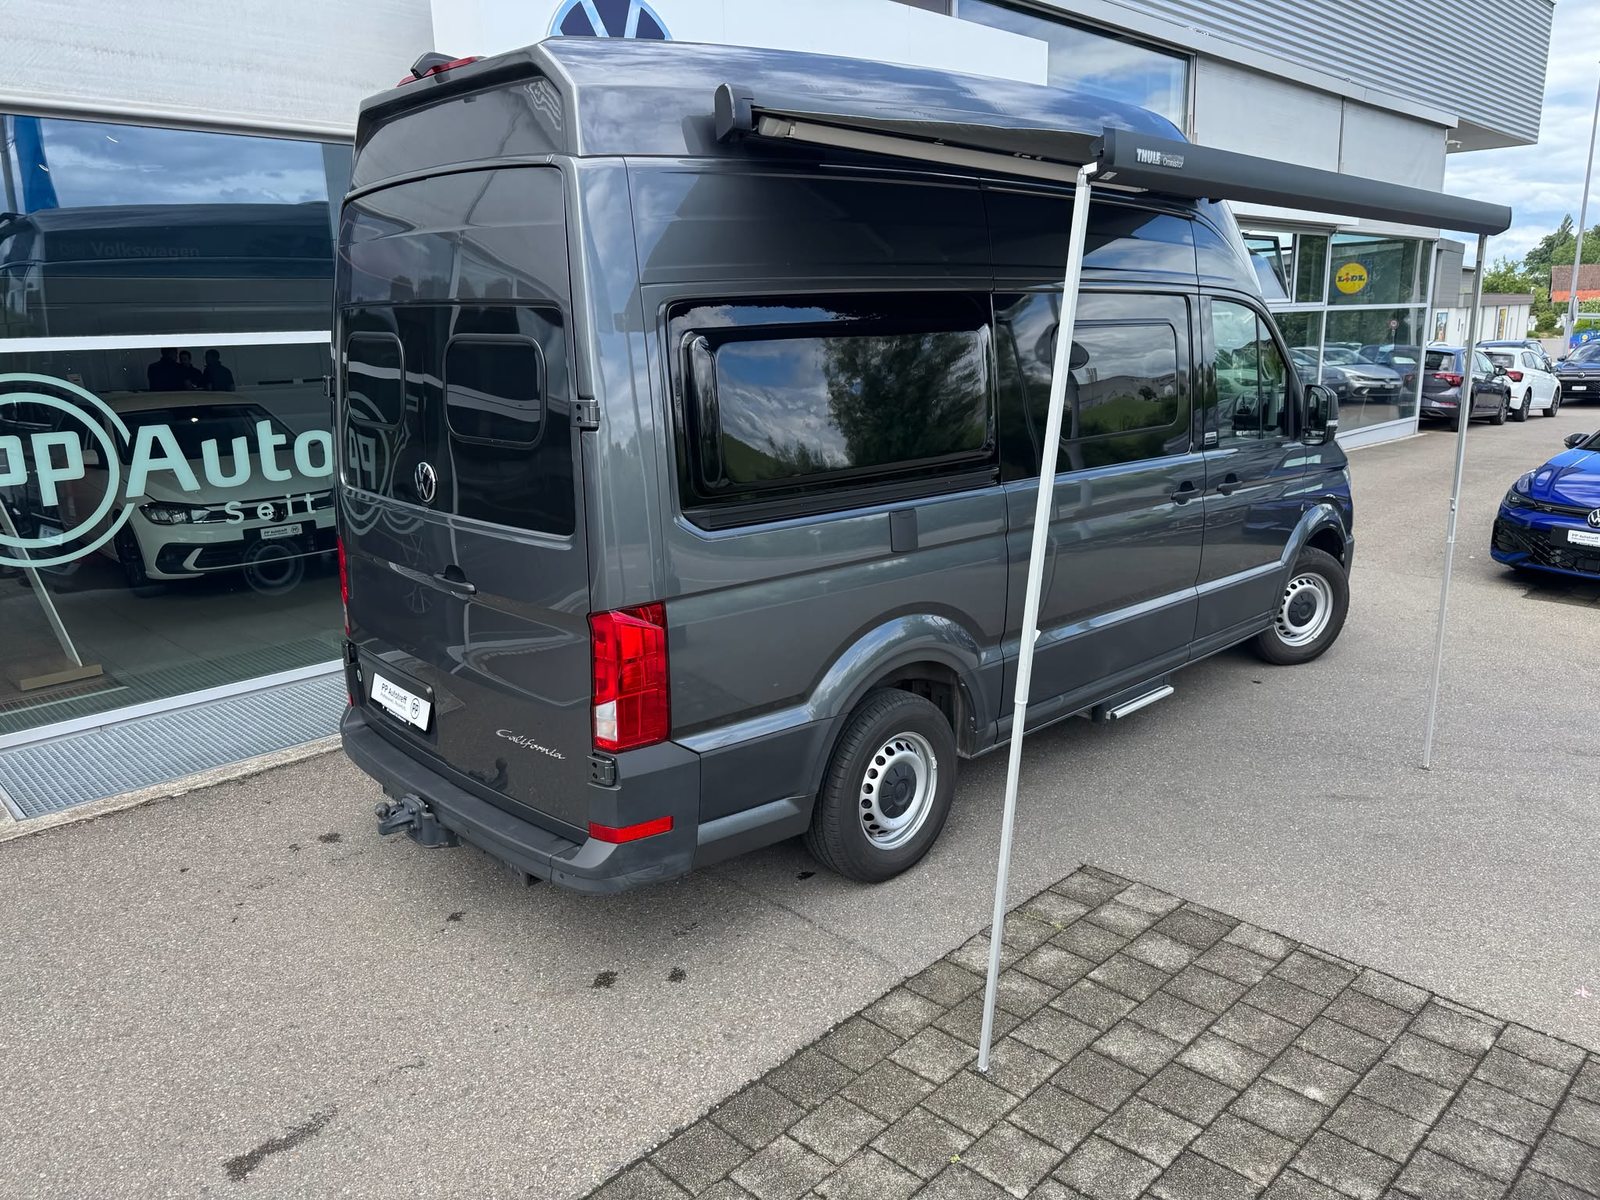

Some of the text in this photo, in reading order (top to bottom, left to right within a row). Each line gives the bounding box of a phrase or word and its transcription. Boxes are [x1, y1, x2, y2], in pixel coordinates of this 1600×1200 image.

[1137, 148, 1161, 165] THULE
[90, 241, 200, 260] Volkswagen
[126, 419, 333, 498] Auto
[224, 493, 317, 526] seit
[382, 683, 388, 692] PP
[495, 728, 566, 760] California
